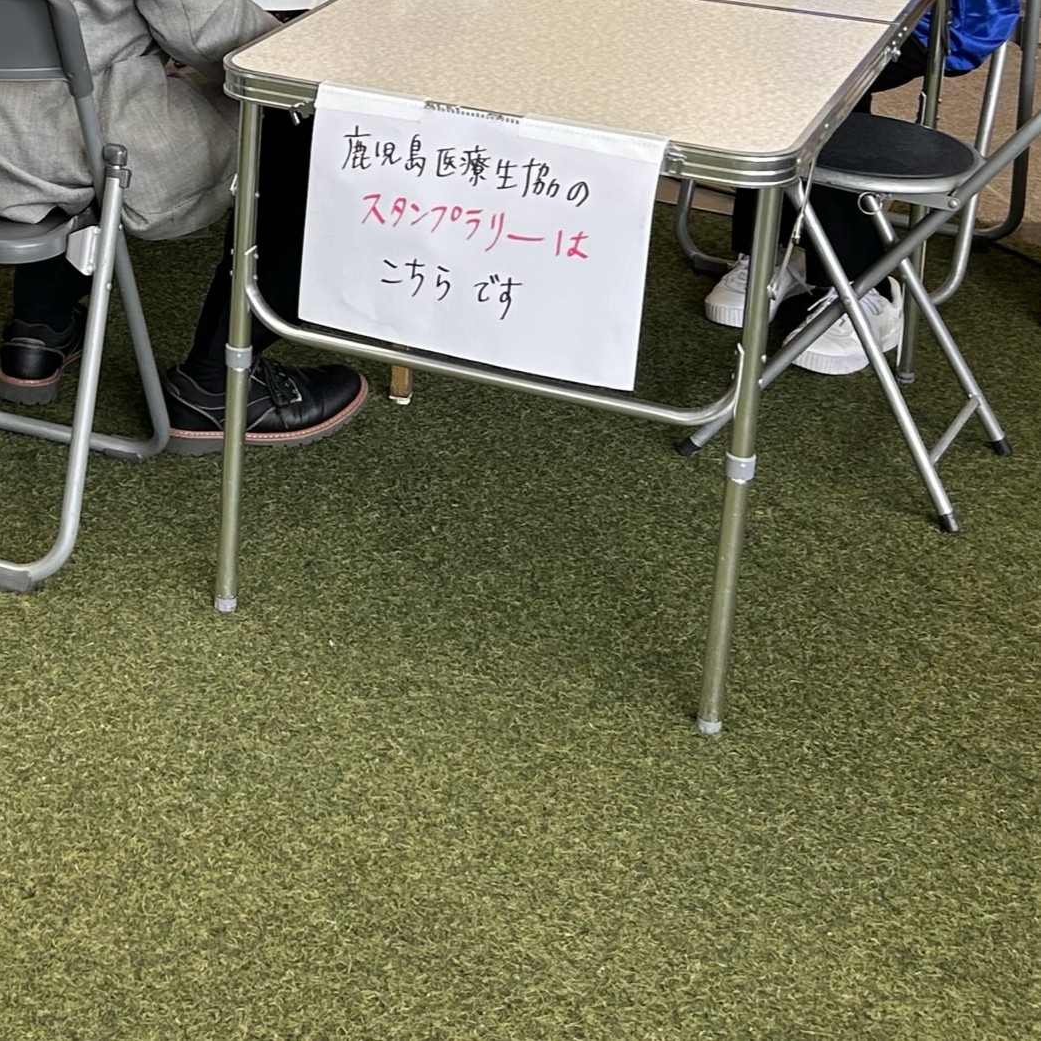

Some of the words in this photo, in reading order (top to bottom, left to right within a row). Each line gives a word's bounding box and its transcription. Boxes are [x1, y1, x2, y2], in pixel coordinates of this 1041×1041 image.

[342, 125, 590, 207] 鹿児島医療生協の
[361, 193, 589, 259] スタンプラリーは
